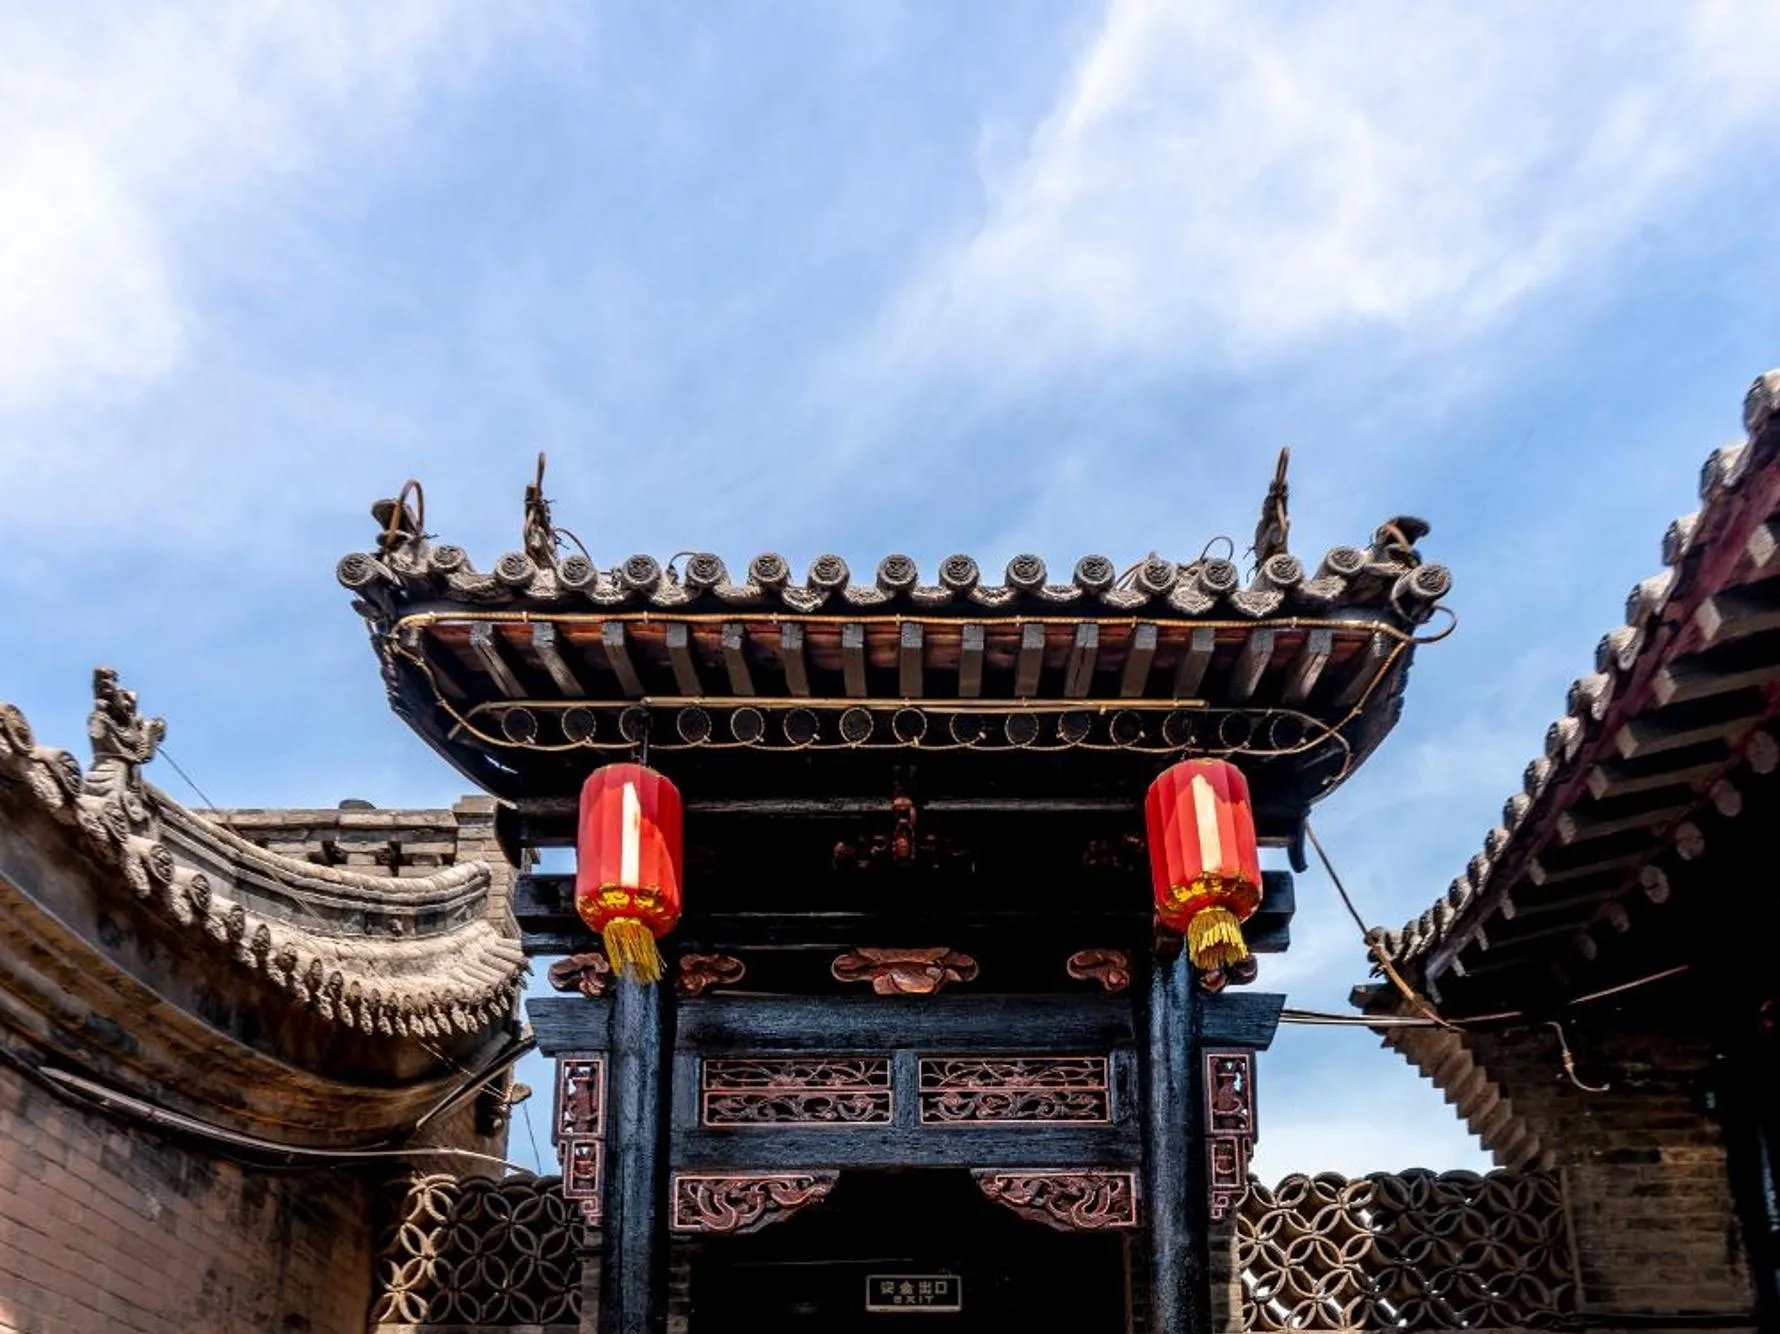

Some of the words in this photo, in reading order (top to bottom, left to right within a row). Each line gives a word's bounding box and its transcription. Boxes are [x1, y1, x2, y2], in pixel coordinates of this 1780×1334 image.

[880, 1280, 947, 1295] 安全出口
[893, 1295, 935, 1304] EXIT
